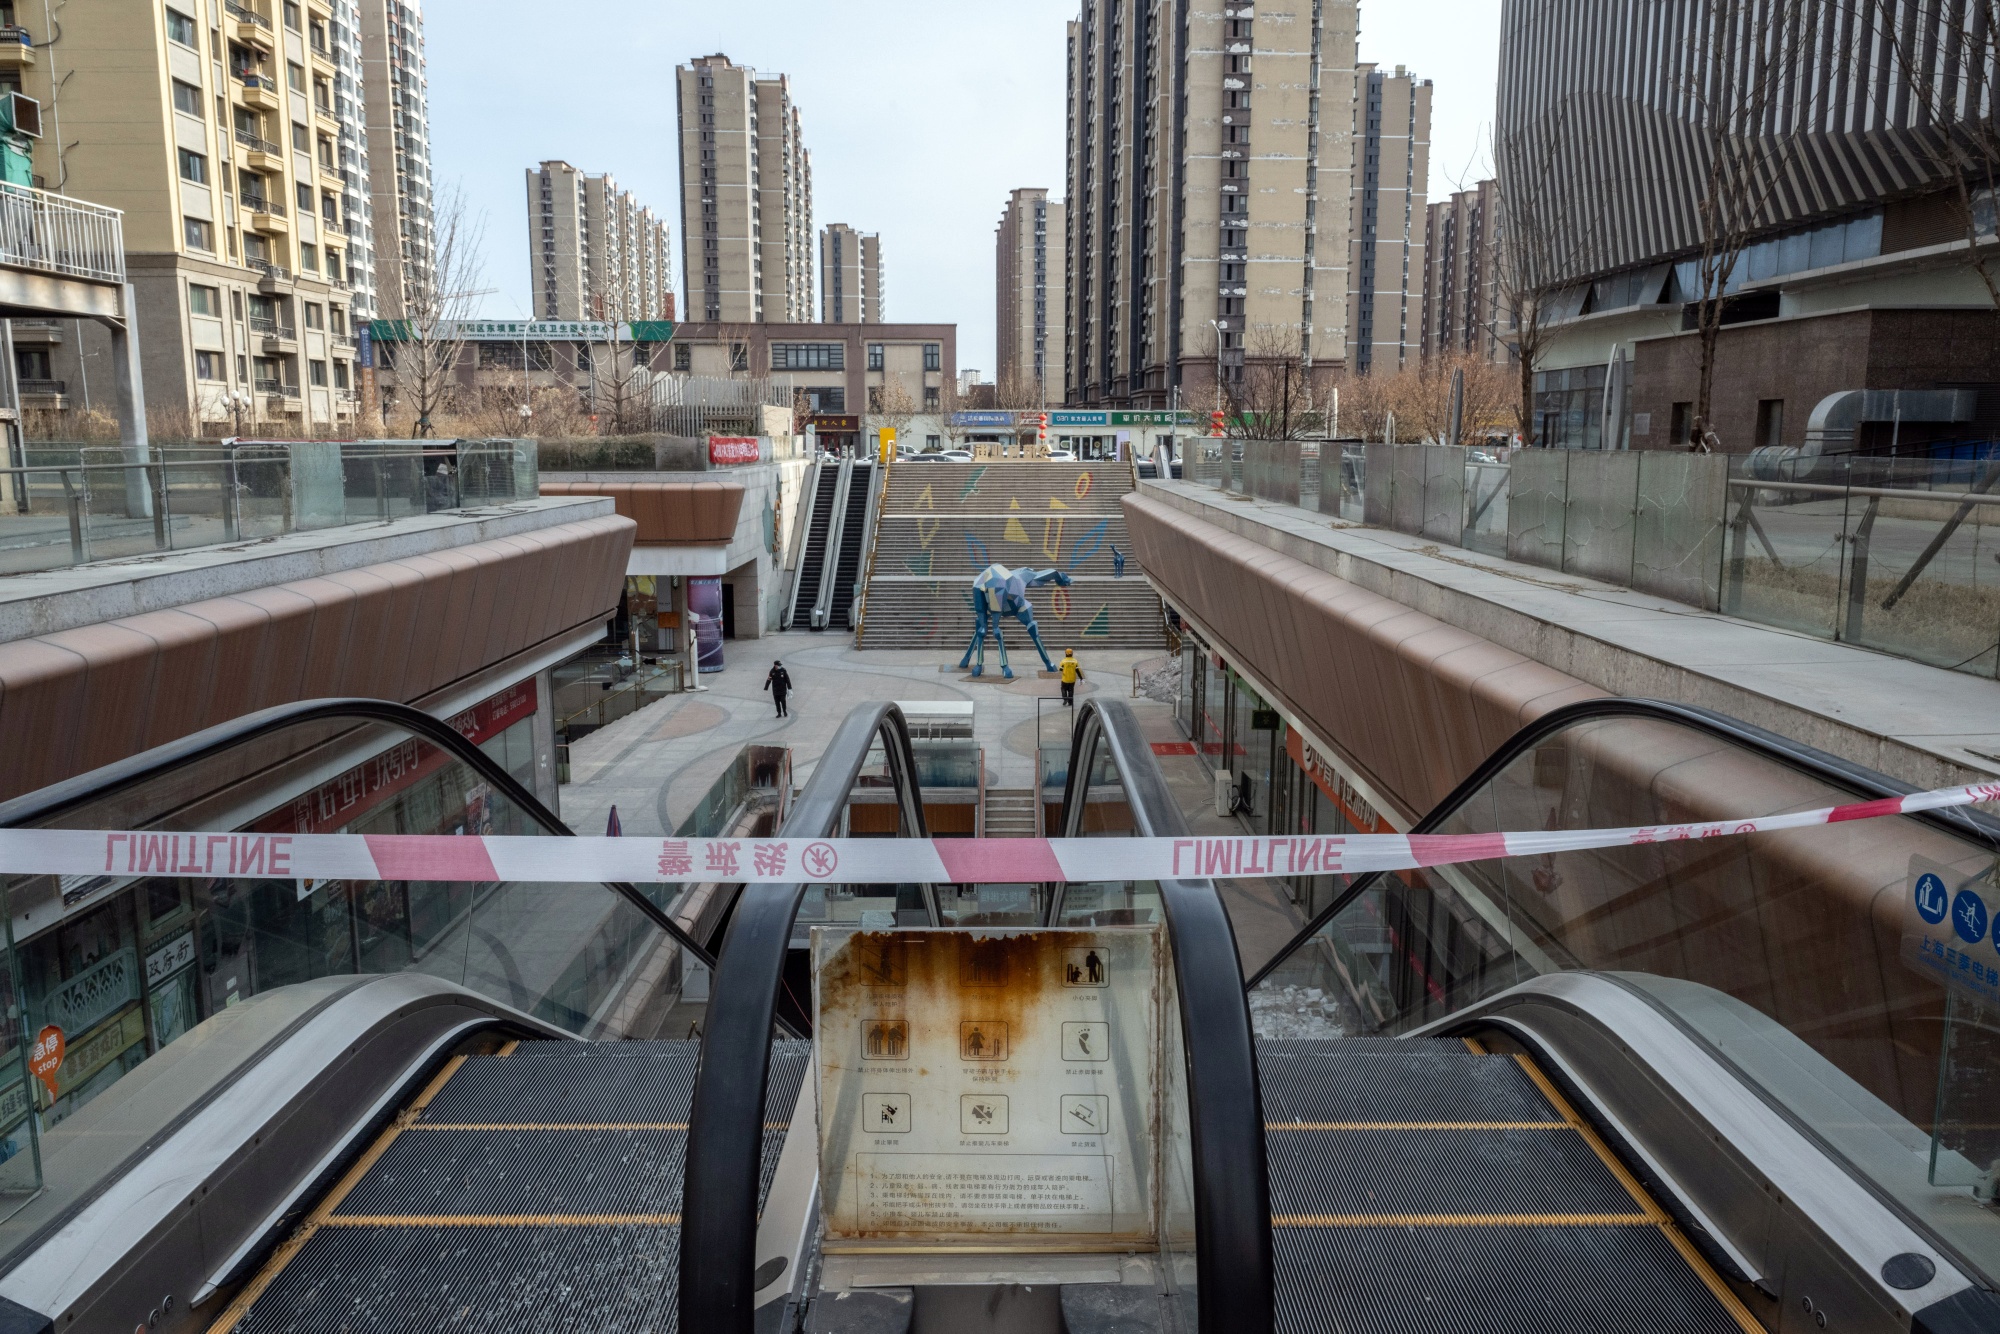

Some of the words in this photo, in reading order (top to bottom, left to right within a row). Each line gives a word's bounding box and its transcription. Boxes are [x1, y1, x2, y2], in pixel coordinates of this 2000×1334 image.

[148, 940, 190, 979] 政府街
[1919, 934, 1999, 987] 上海三菱电梯
[33, 1033, 59, 1062] 急停
[37, 1056, 58, 1075] stop
